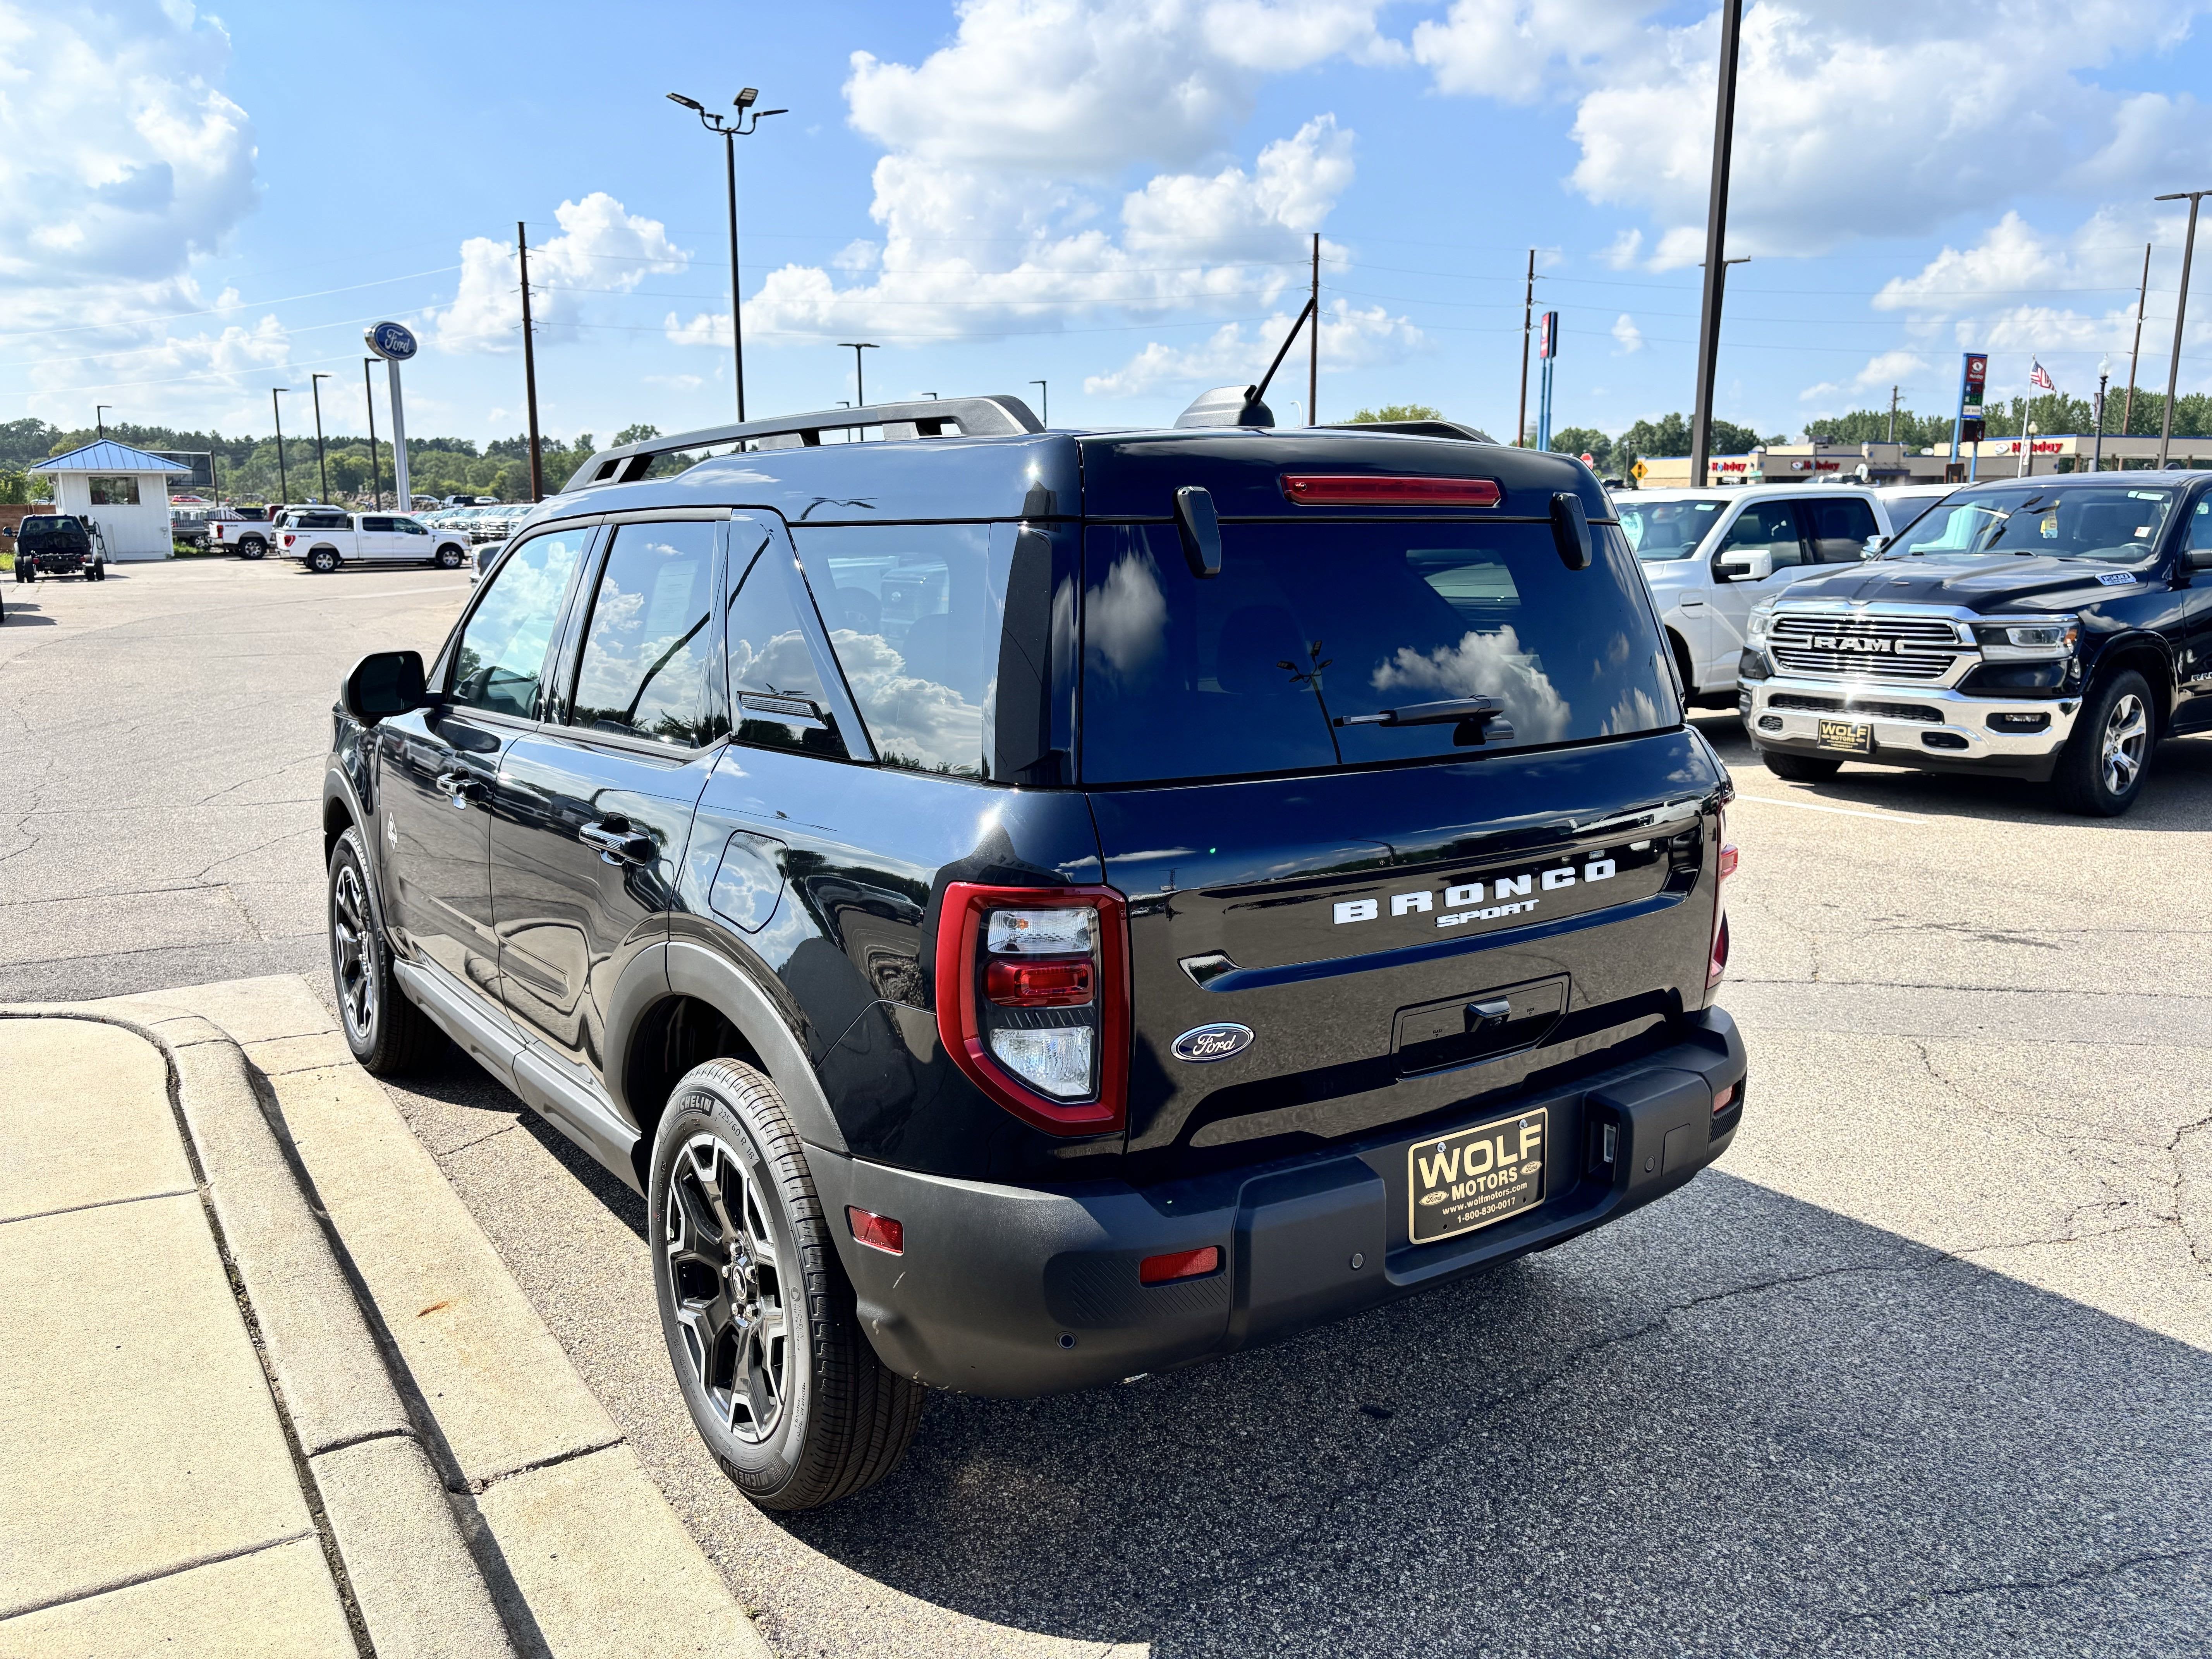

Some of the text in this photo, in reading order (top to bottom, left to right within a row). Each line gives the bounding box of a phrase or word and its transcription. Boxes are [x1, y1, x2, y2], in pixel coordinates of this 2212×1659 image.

[385, 328, 410, 353] Ford
[1814, 636, 1892, 652] RAM
[1822, 724, 1867, 737] WOLF
[1333, 859, 1616, 925] BRONCO
[1435, 898, 1540, 928] SPORT
[1192, 1032, 1237, 1055] Ford
[672, 1095, 712, 1116] MICHELIN
[718, 1108, 754, 1160] 225/60 R 18
[1418, 1123, 1541, 1189] WOLF
[1525, 1163, 1538, 1172] Ford
[1451, 1166, 1518, 1201] MOTORS
[1426, 1194, 1442, 1204] Ford
[1442, 1182, 1527, 1215] www.wolfmotors.com
[1457, 1197, 1516, 1223] 1-800-830-0017
[723, 1459, 769, 1487] MICHELIN
